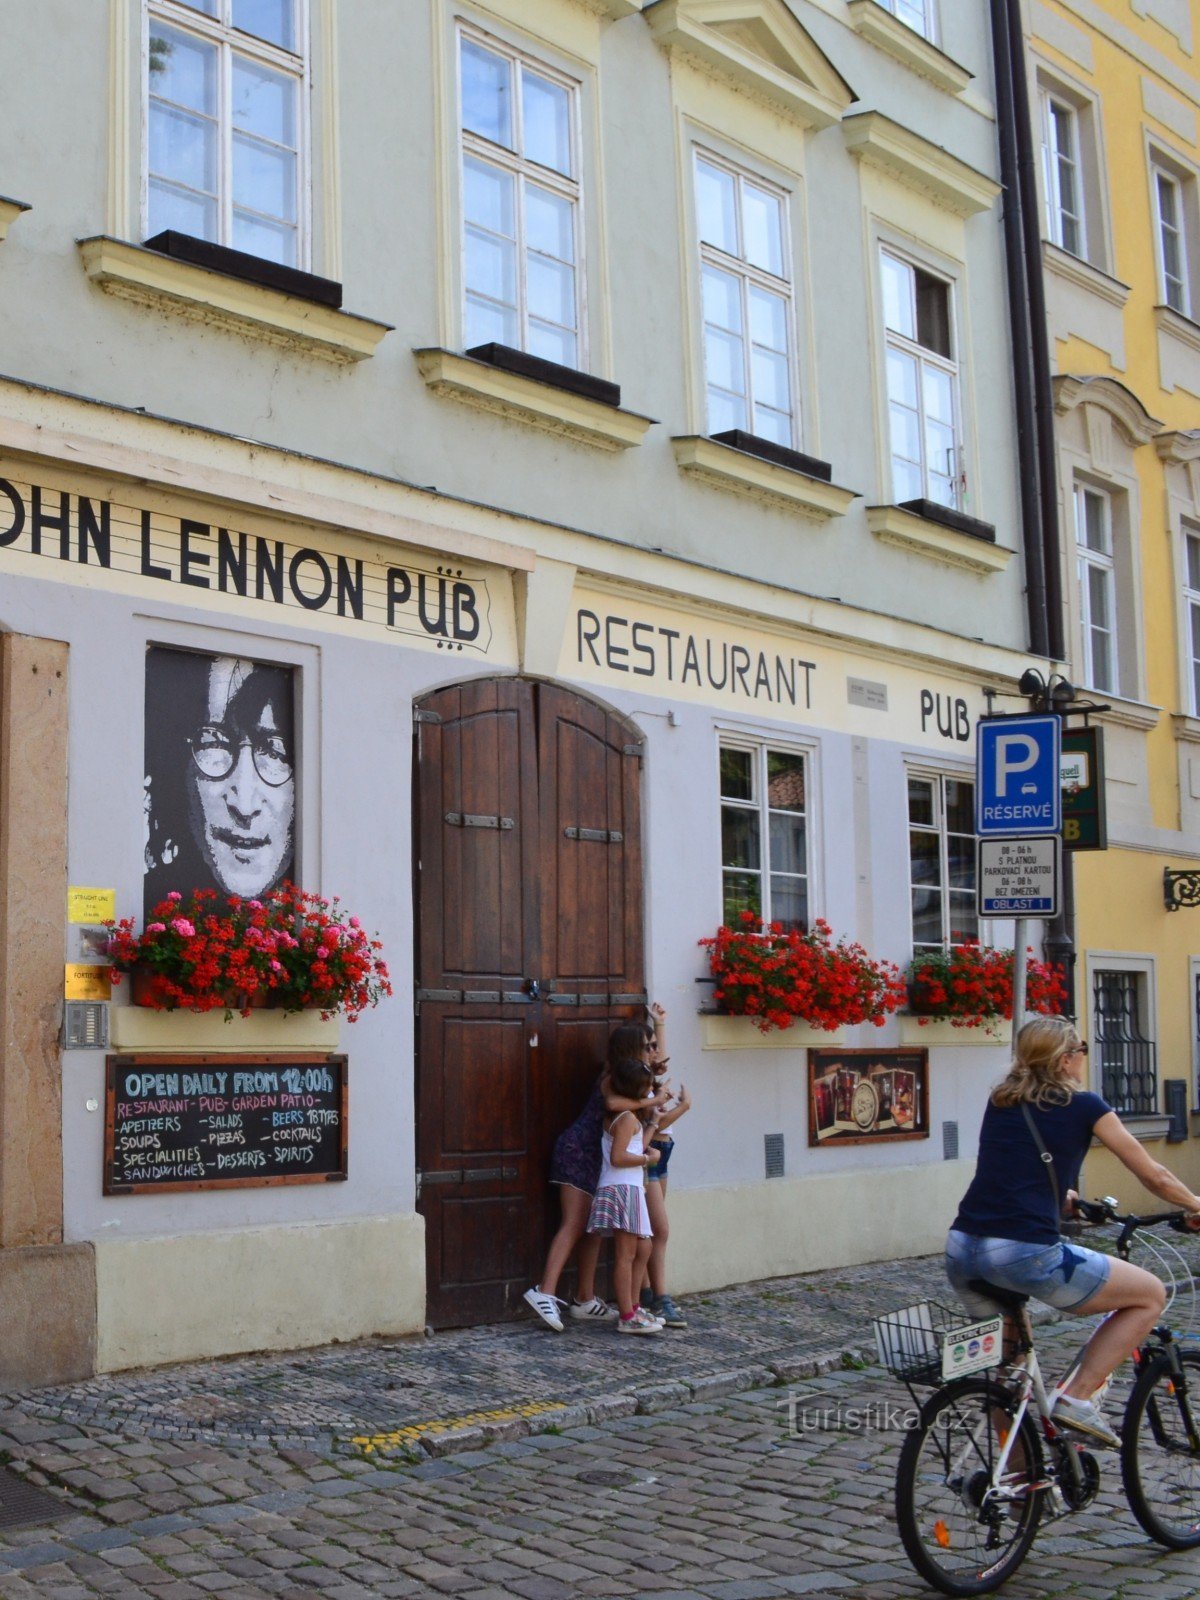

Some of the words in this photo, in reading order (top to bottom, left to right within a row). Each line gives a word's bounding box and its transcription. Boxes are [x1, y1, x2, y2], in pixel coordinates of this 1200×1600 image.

[140, 510, 364, 621] LENNON
[386, 567, 480, 642] PUB
[576, 608, 817, 710] RESTAURANT
[920, 689, 970, 742] PUB
[995, 733, 1040, 798] P
[984, 803, 1052, 820] RÉSERVÉ
[1017, 846, 1026, 854] 06
[998, 857, 1003, 865] S
[1006, 856, 1037, 865] PLATNOU
[1023, 865, 1052, 875] KARTOU
[995, 887, 1008, 896] BEZ
[992, 899, 1032, 909] OBLAST
[125, 1073, 179, 1097] OPEN
[183, 1072, 228, 1095] DAILY
[233, 1071, 279, 1094] FROM
[117, 1098, 189, 1119] RESTAURANT
[232, 1094, 277, 1112] GARDEN
[272, 1110, 304, 1127] BEERS
[272, 1126, 322, 1143] COCKTAILS
[123, 1146, 201, 1168] SPECIALITIES
[274, 1145, 314, 1163] SPIRITS
[124, 1162, 205, 1180] SANDWICHES
